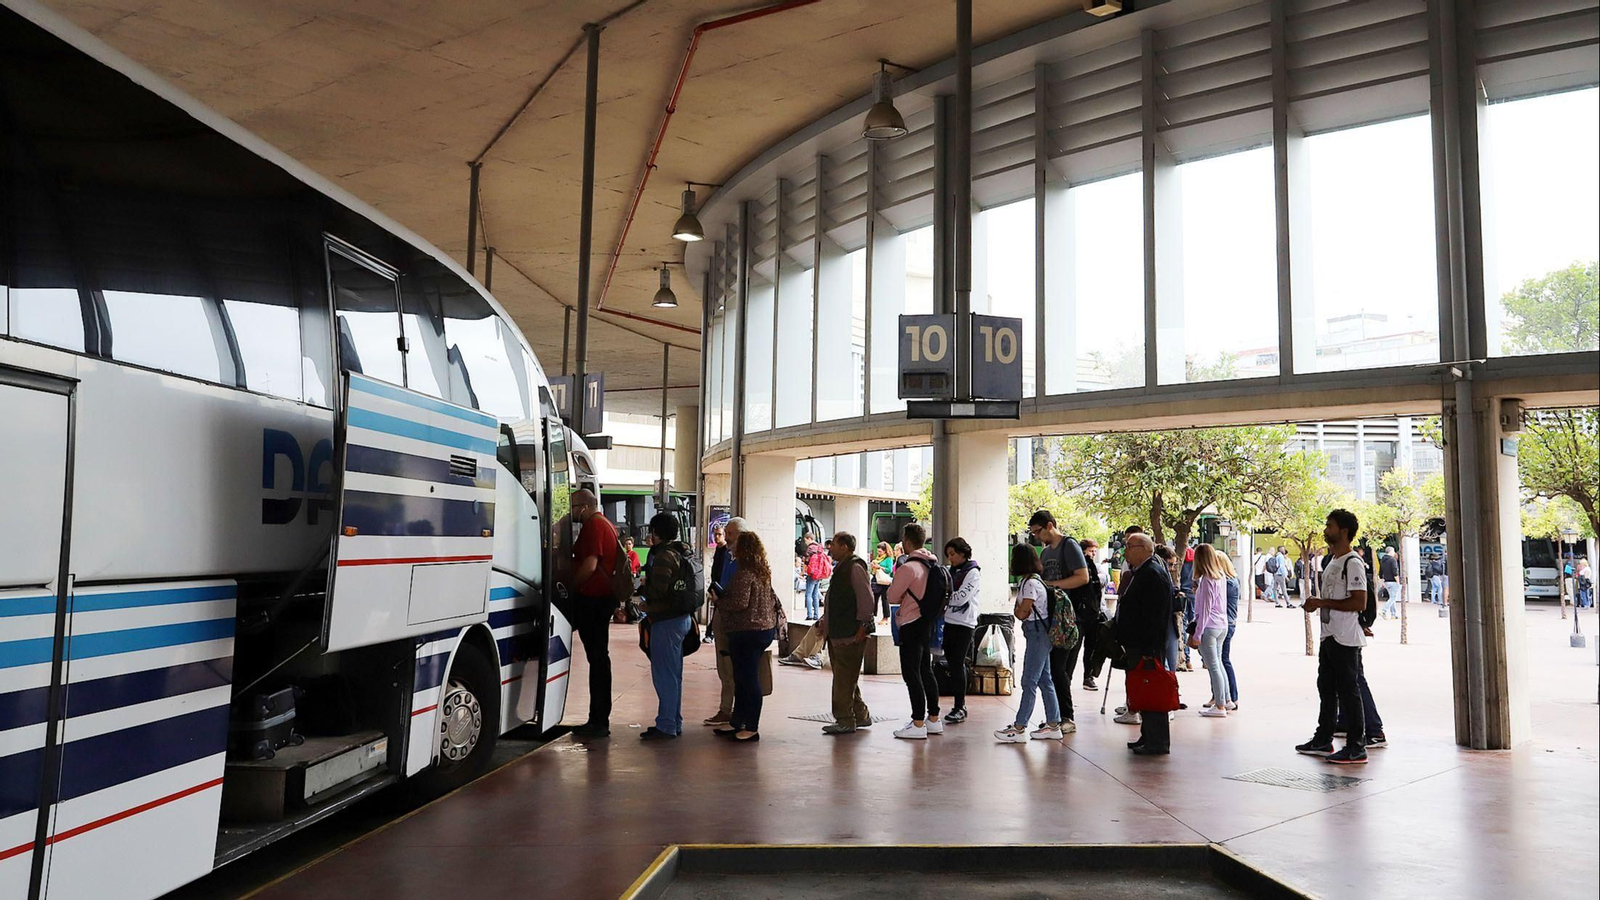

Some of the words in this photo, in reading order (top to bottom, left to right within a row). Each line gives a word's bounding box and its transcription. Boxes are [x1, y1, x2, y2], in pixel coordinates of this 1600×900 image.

[905, 324, 948, 362] 10
[979, 325, 1018, 365] 10
[550, 383, 567, 410] 11
[588, 381, 598, 409] 11
